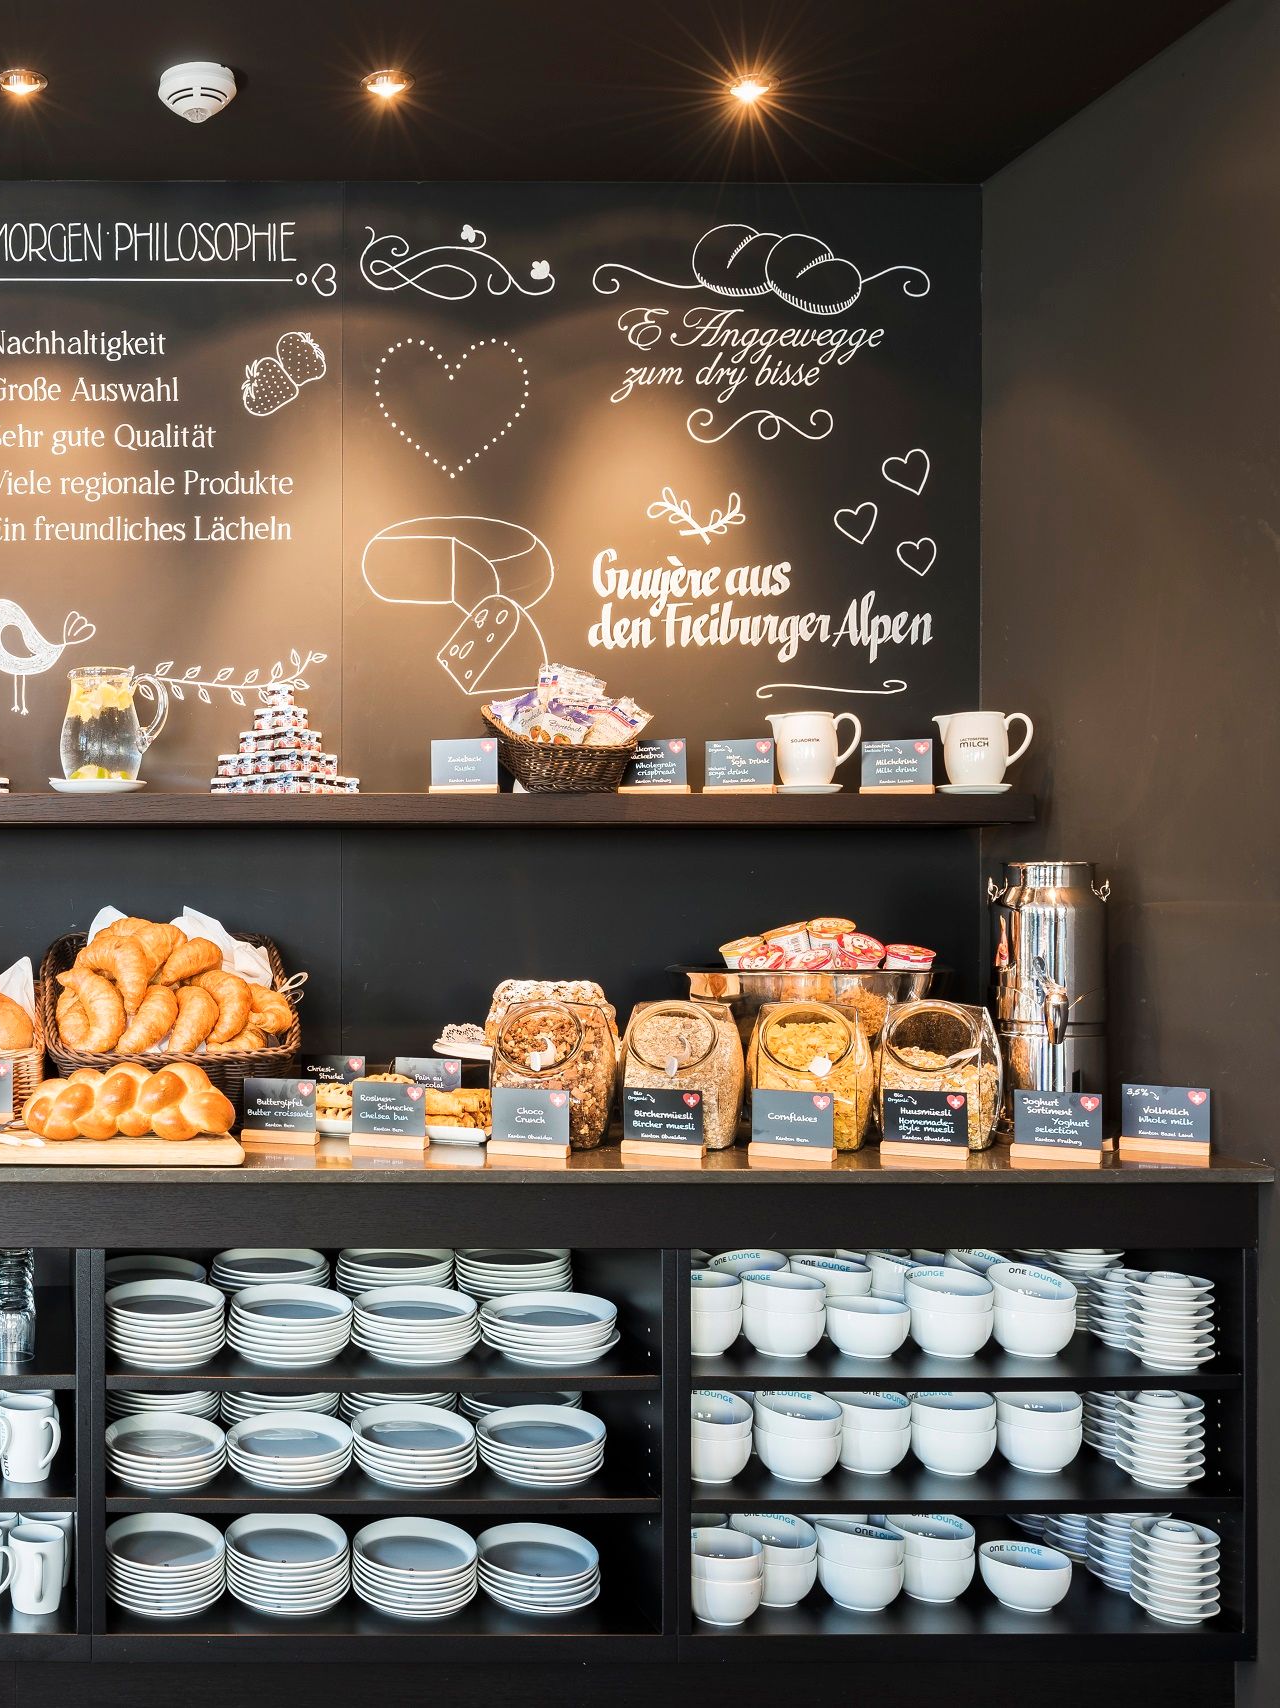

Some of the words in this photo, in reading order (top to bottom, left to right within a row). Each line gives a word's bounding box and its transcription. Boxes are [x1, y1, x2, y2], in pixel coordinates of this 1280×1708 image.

[115, 222, 296, 262] PHILOSOPHIE
[618, 308, 668, 351] E
[670, 307, 884, 365] Anggewegge
[610, 367, 684, 403] zum
[696, 352, 748, 403] dry
[755, 356, 820, 386] bisse
[71, 377, 178, 402] Auswahl
[52, 427, 104, 454] gute
[115, 423, 216, 450] Qualität
[61, 470, 175, 501] regionale
[184, 470, 293, 495] Produkte
[34, 516, 185, 541] freundliches
[194, 516, 293, 541] Lächeln
[725, 562, 791, 596] aus
[588, 599, 656, 649] den
[663, 598, 831, 663] Freiburger
[832, 590, 933, 664] Alpen
[631, 752, 665, 760] äckebrot
[635, 761, 676, 770] Wholegrain
[731, 759, 747, 767] Soja
[875, 758, 918, 766] Milchdrink
[637, 768, 676, 779] crispbread
[318, 1072, 345, 1080] Strudel
[415, 1073, 431, 1081] Pain
[360, 1094, 397, 1102] Rosinen-
[1126, 1088, 1150, 1097] 3,5%
[256, 1097, 304, 1109] Buttergipfel
[377, 1103, 415, 1113] Schnecke
[1022, 1097, 1060, 1108] Joghurt
[247, 1108, 272, 1117] Butter
[273, 1109, 314, 1118] croissants
[359, 1111, 391, 1121] Chelsea
[393, 1113, 409, 1121] bun
[516, 1107, 545, 1116] Choco
[634, 1109, 694, 1120] Birchermüesli
[900, 1106, 952, 1117] Huusmüesli
[1026, 1106, 1073, 1116] Sortiment
[1142, 1105, 1189, 1116] Vollmilch
[515, 1116, 546, 1124] Crunch
[767, 1112, 818, 1123] Cornflakes
[898, 1117, 954, 1127] Homemade-
[1051, 1117, 1090, 1128] Yoghurt
[1138, 1115, 1168, 1125] Whole
[1170, 1117, 1194, 1126] milk
[632, 1120, 663, 1129] Bircher
[666, 1122, 696, 1131] muesli
[898, 1124, 921, 1135] style
[923, 1125, 955, 1134] muesli
[1034, 1126, 1079, 1135] selection
[714, 1256, 727, 1266] ONE
[728, 1252, 761, 1262] LOUNGE
[817, 1261, 851, 1273] LOUNGE
[913, 1270, 945, 1278] LOUNGE
[1008, 1267, 1027, 1276] ONE
[1028, 1271, 1062, 1288] LOUNGE
[698, 1390, 733, 1404] LOUNGE
[931, 1513, 964, 1530] LOUNGE
[854, 1527, 874, 1536] ONE
[989, 1544, 1005, 1553] ONE
[1005, 1545, 1043, 1556] LOUNGE
